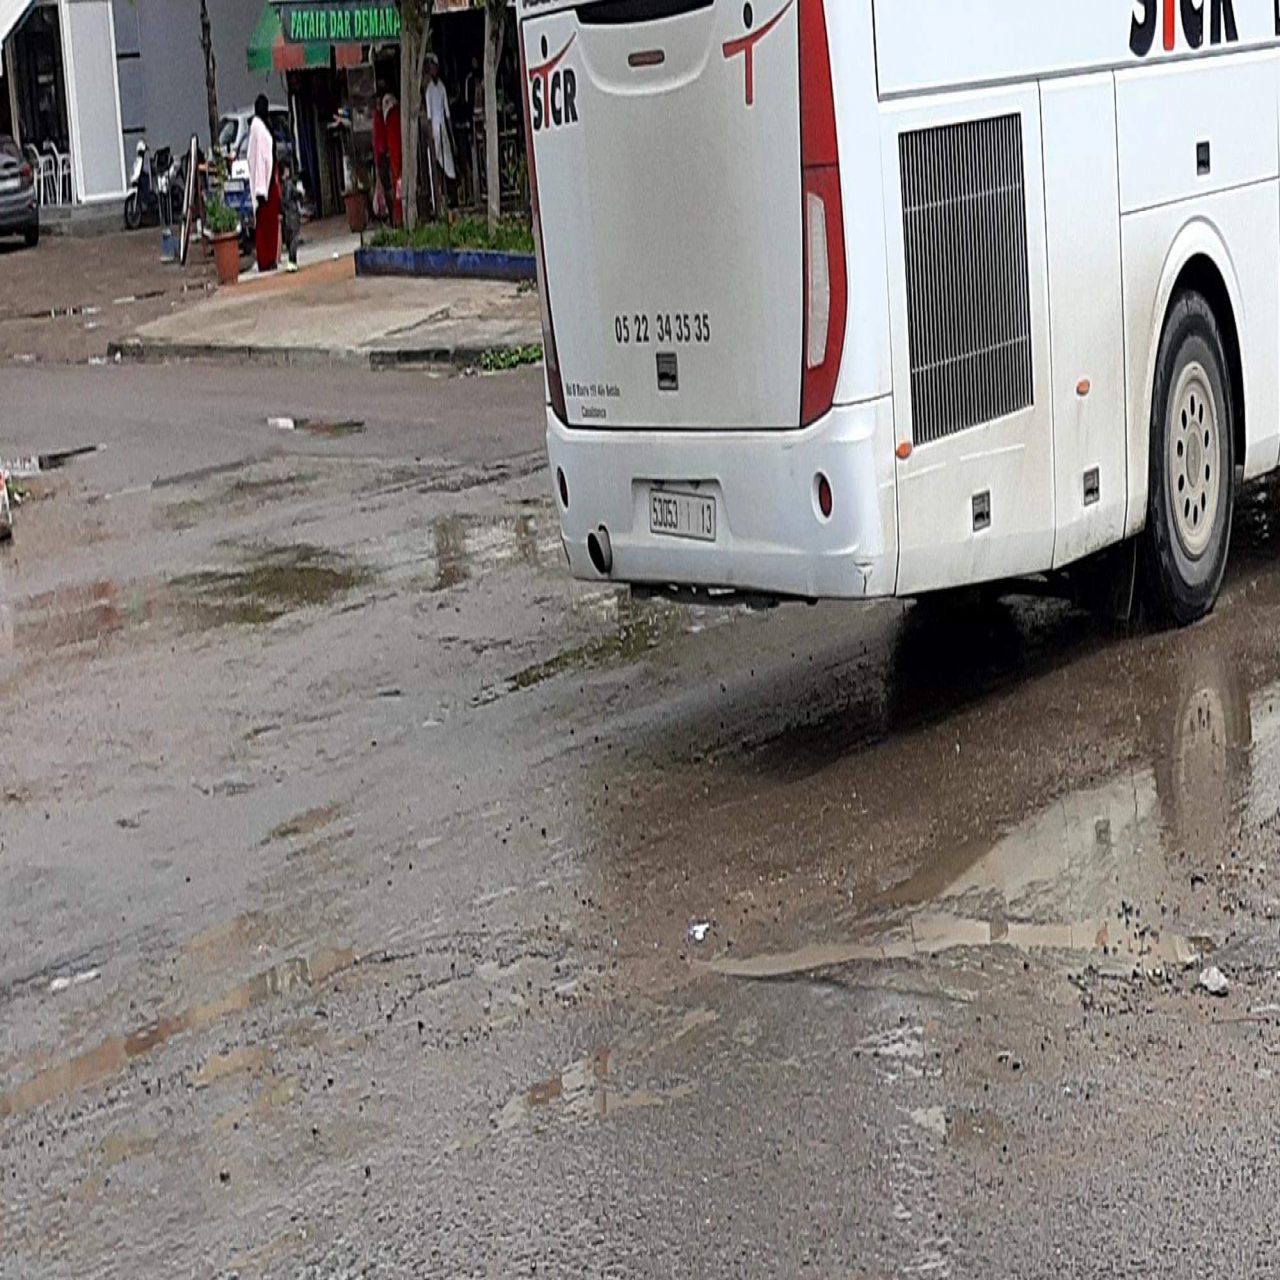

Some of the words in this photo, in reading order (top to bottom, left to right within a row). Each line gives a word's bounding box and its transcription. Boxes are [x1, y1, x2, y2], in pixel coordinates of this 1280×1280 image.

[330, 10, 351, 39] DAR
[615, 315, 630, 343] 05
[634, 314, 650, 342] 22
[656, 313, 672, 342] 34
[675, 313, 691, 342] 35
[694, 313, 711, 342] 35
